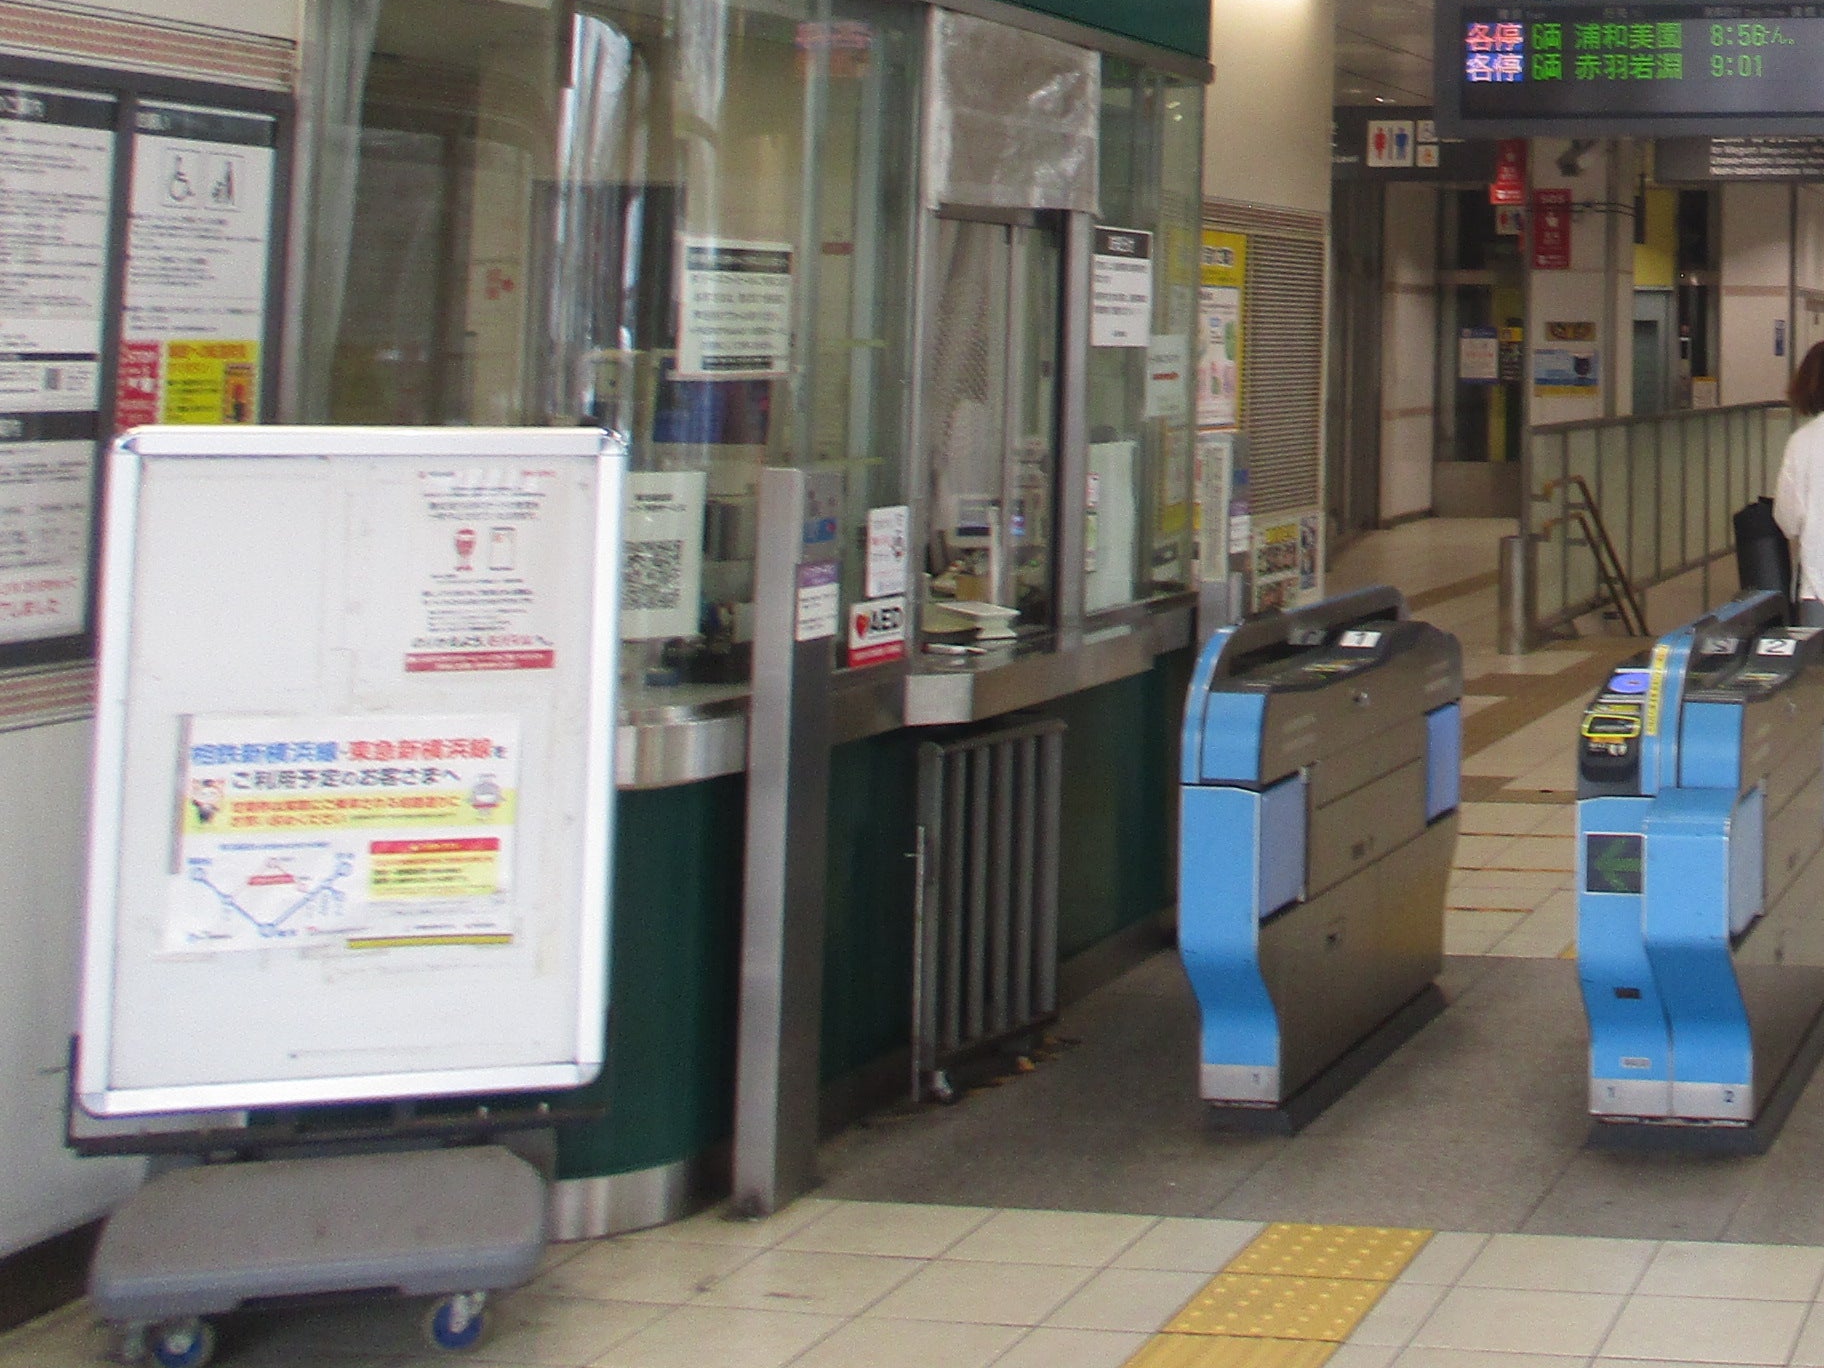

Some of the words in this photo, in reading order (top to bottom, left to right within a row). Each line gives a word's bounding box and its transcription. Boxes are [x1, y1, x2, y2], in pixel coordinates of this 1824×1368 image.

[1466, 22, 1524, 51] 各停
[1573, 21, 1682, 49] 浦和美園
[1466, 52, 1523, 82] 各停
[1710, 54, 1763, 78] 9:01
